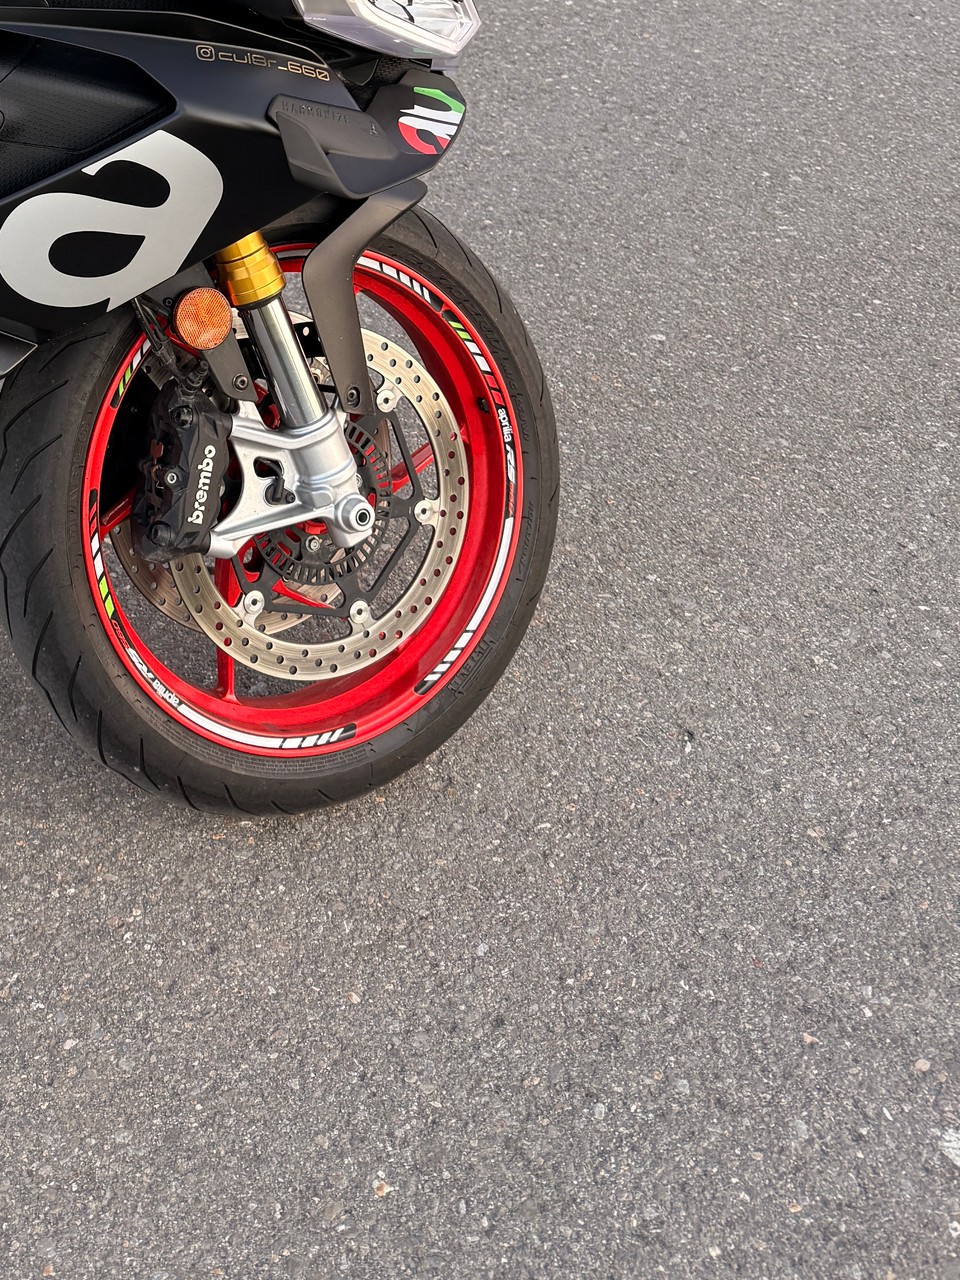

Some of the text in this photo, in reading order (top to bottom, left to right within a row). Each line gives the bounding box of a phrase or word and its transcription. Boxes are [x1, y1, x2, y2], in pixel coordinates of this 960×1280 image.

[497, 407, 514, 442] aprilia
[187, 444, 216, 525] brembo
[152, 679, 180, 708] aprilia
